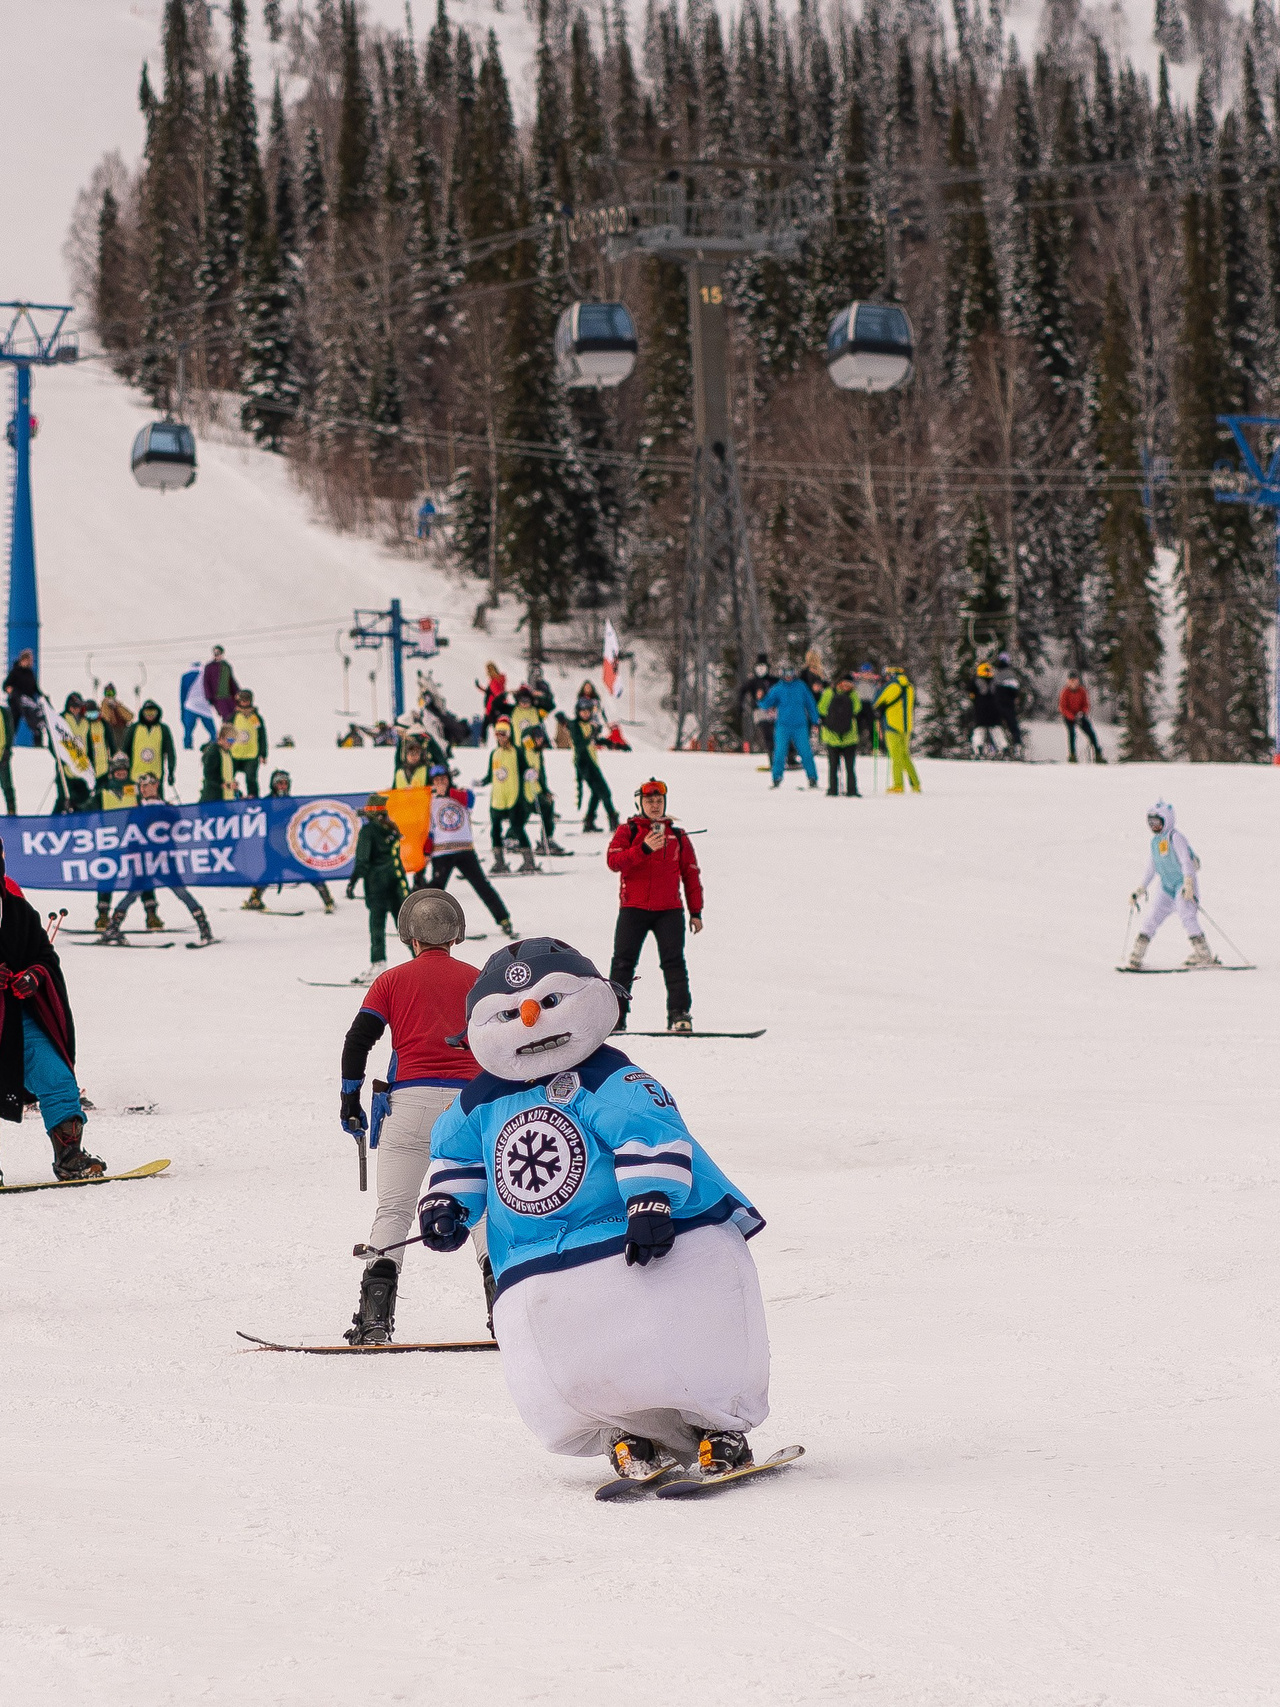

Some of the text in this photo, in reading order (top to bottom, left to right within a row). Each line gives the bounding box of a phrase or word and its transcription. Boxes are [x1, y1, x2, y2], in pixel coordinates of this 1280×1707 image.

[21, 806, 268, 856] КУЗБАССКИЙ
[61, 846, 237, 883] ПОЛИТЕХ
[642, 1083, 678, 1113] 54
[495, 1109, 580, 1172] ХОККЕЙНЫЙ КЛУБ СИБИРЬ
[497, 1154, 584, 1214] НОВОСИБИРСКАЯ ОБЛАСТЬ
